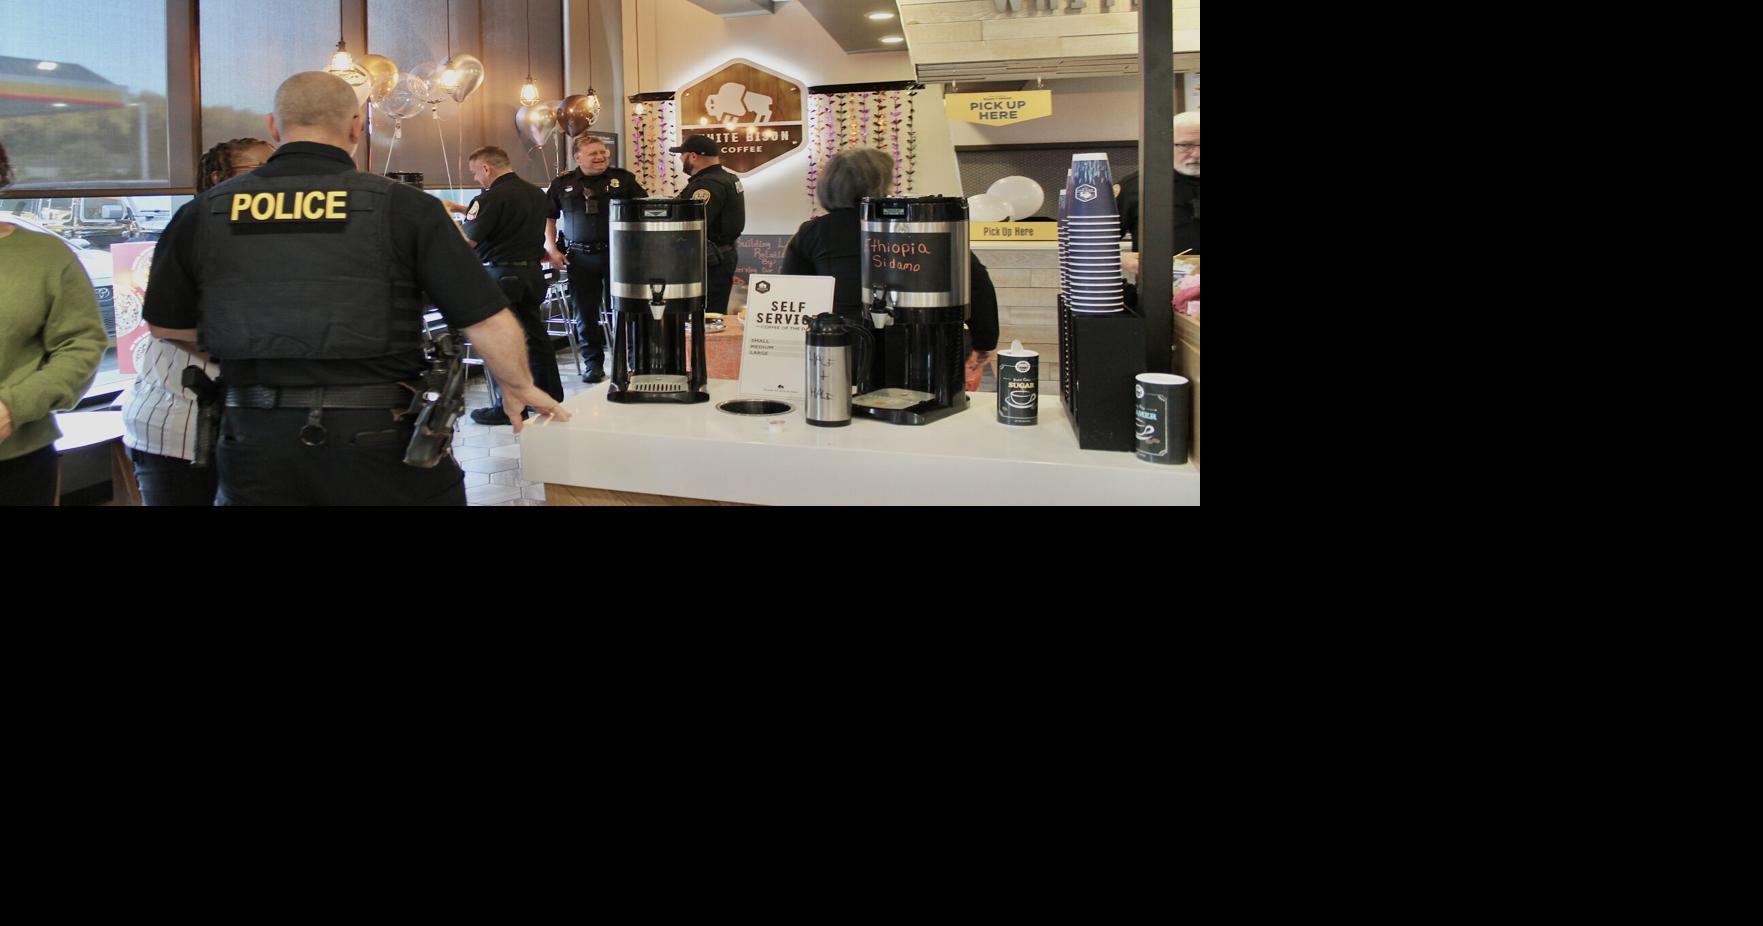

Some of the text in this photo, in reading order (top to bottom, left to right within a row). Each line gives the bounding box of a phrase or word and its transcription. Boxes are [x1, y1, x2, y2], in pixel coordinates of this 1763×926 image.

[969, 100, 1026, 111] PICK UP
[979, 110, 1018, 120] HERE
[701, 130, 789, 144] HITE BISON
[720, 145, 763, 154] COFFEE
[230, 190, 348, 221] POLICE
[983, 226, 1034, 237] Pick Up Here
[863, 237, 931, 257] Ethiopia
[872, 254, 921, 272] Sidamo
[771, 301, 806, 313] SELF
[756, 312, 809, 326] SERVIC
[1008, 381, 1035, 390] SUGAR
